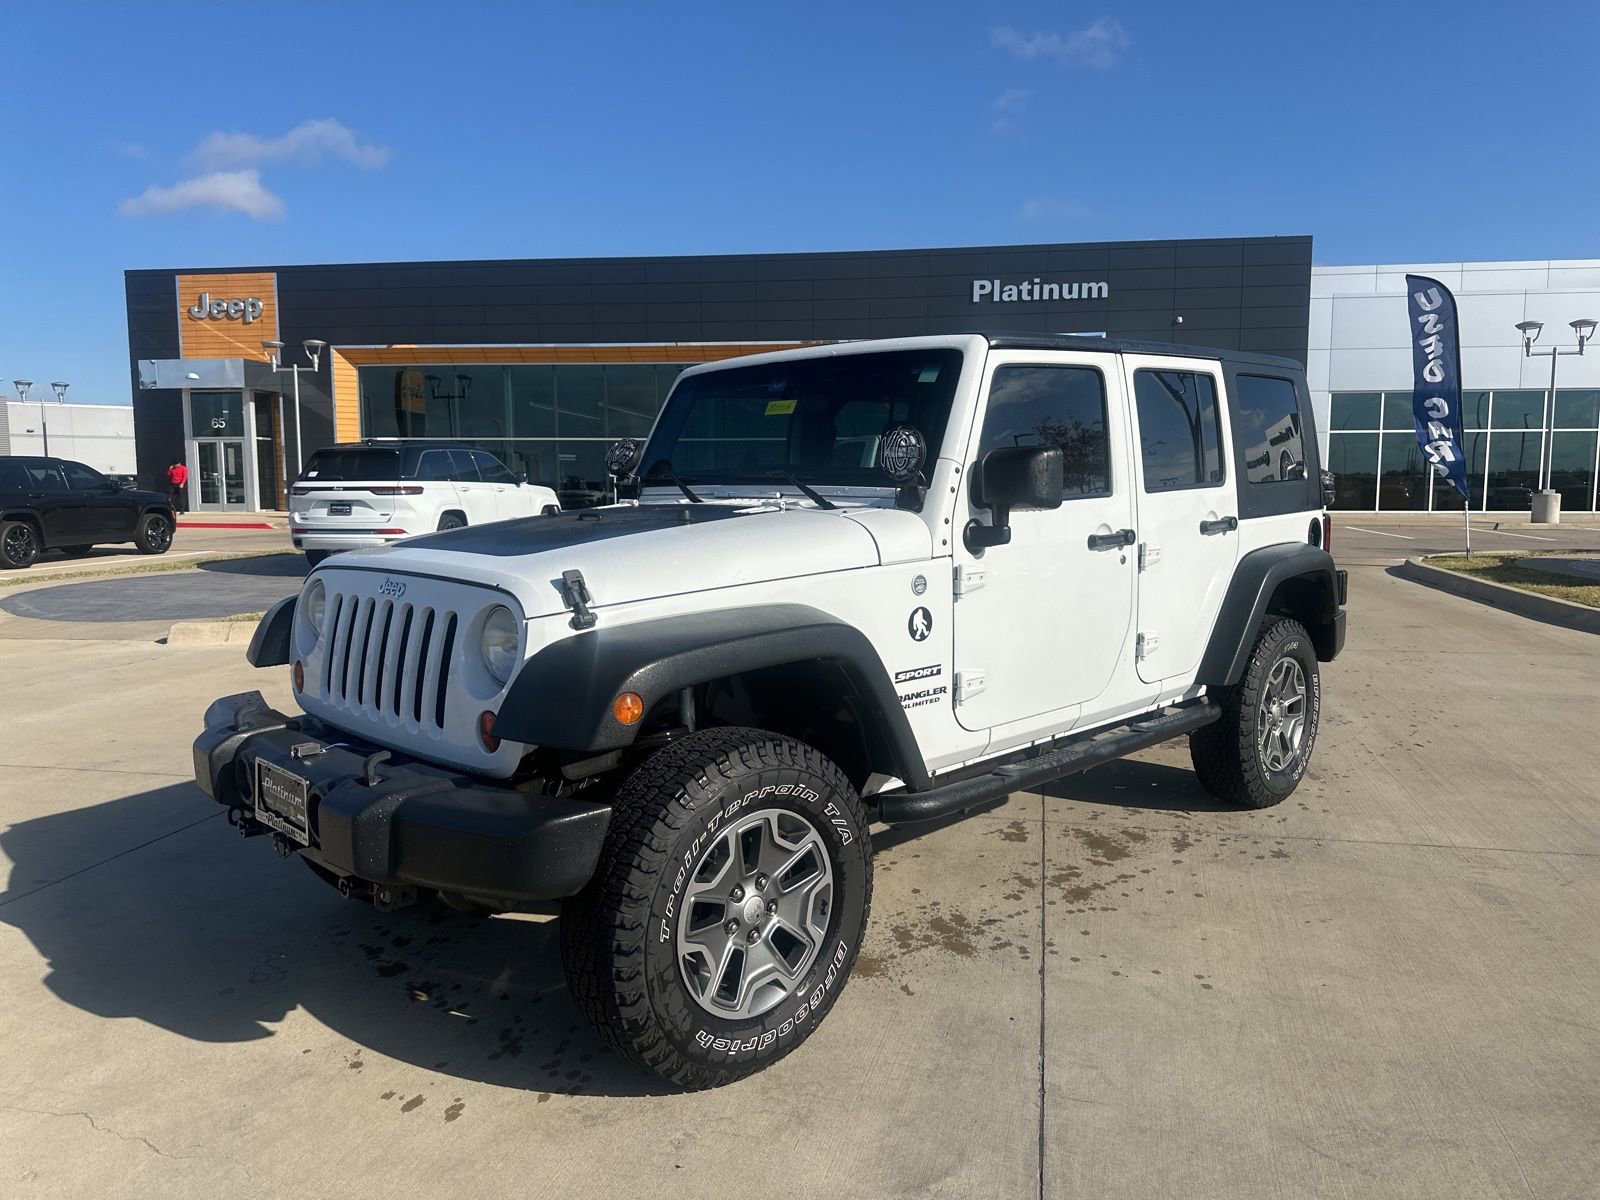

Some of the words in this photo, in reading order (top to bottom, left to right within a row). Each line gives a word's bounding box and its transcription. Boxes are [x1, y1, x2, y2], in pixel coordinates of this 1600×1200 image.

[973, 278, 1109, 302] Platinum
[189, 292, 264, 323] Jeep
[211, 417, 226, 429] 65
[378, 577, 407, 600] Jeep
[896, 667, 940, 681] SPORT
[899, 686, 947, 702] RANGLER
[902, 697, 940, 709] NLIMITED
[262, 777, 305, 809] Platinum
[659, 784, 819, 943] Trail-Terrain
[824, 802, 853, 846] T/A
[696, 941, 848, 1055] BFGoodrich
